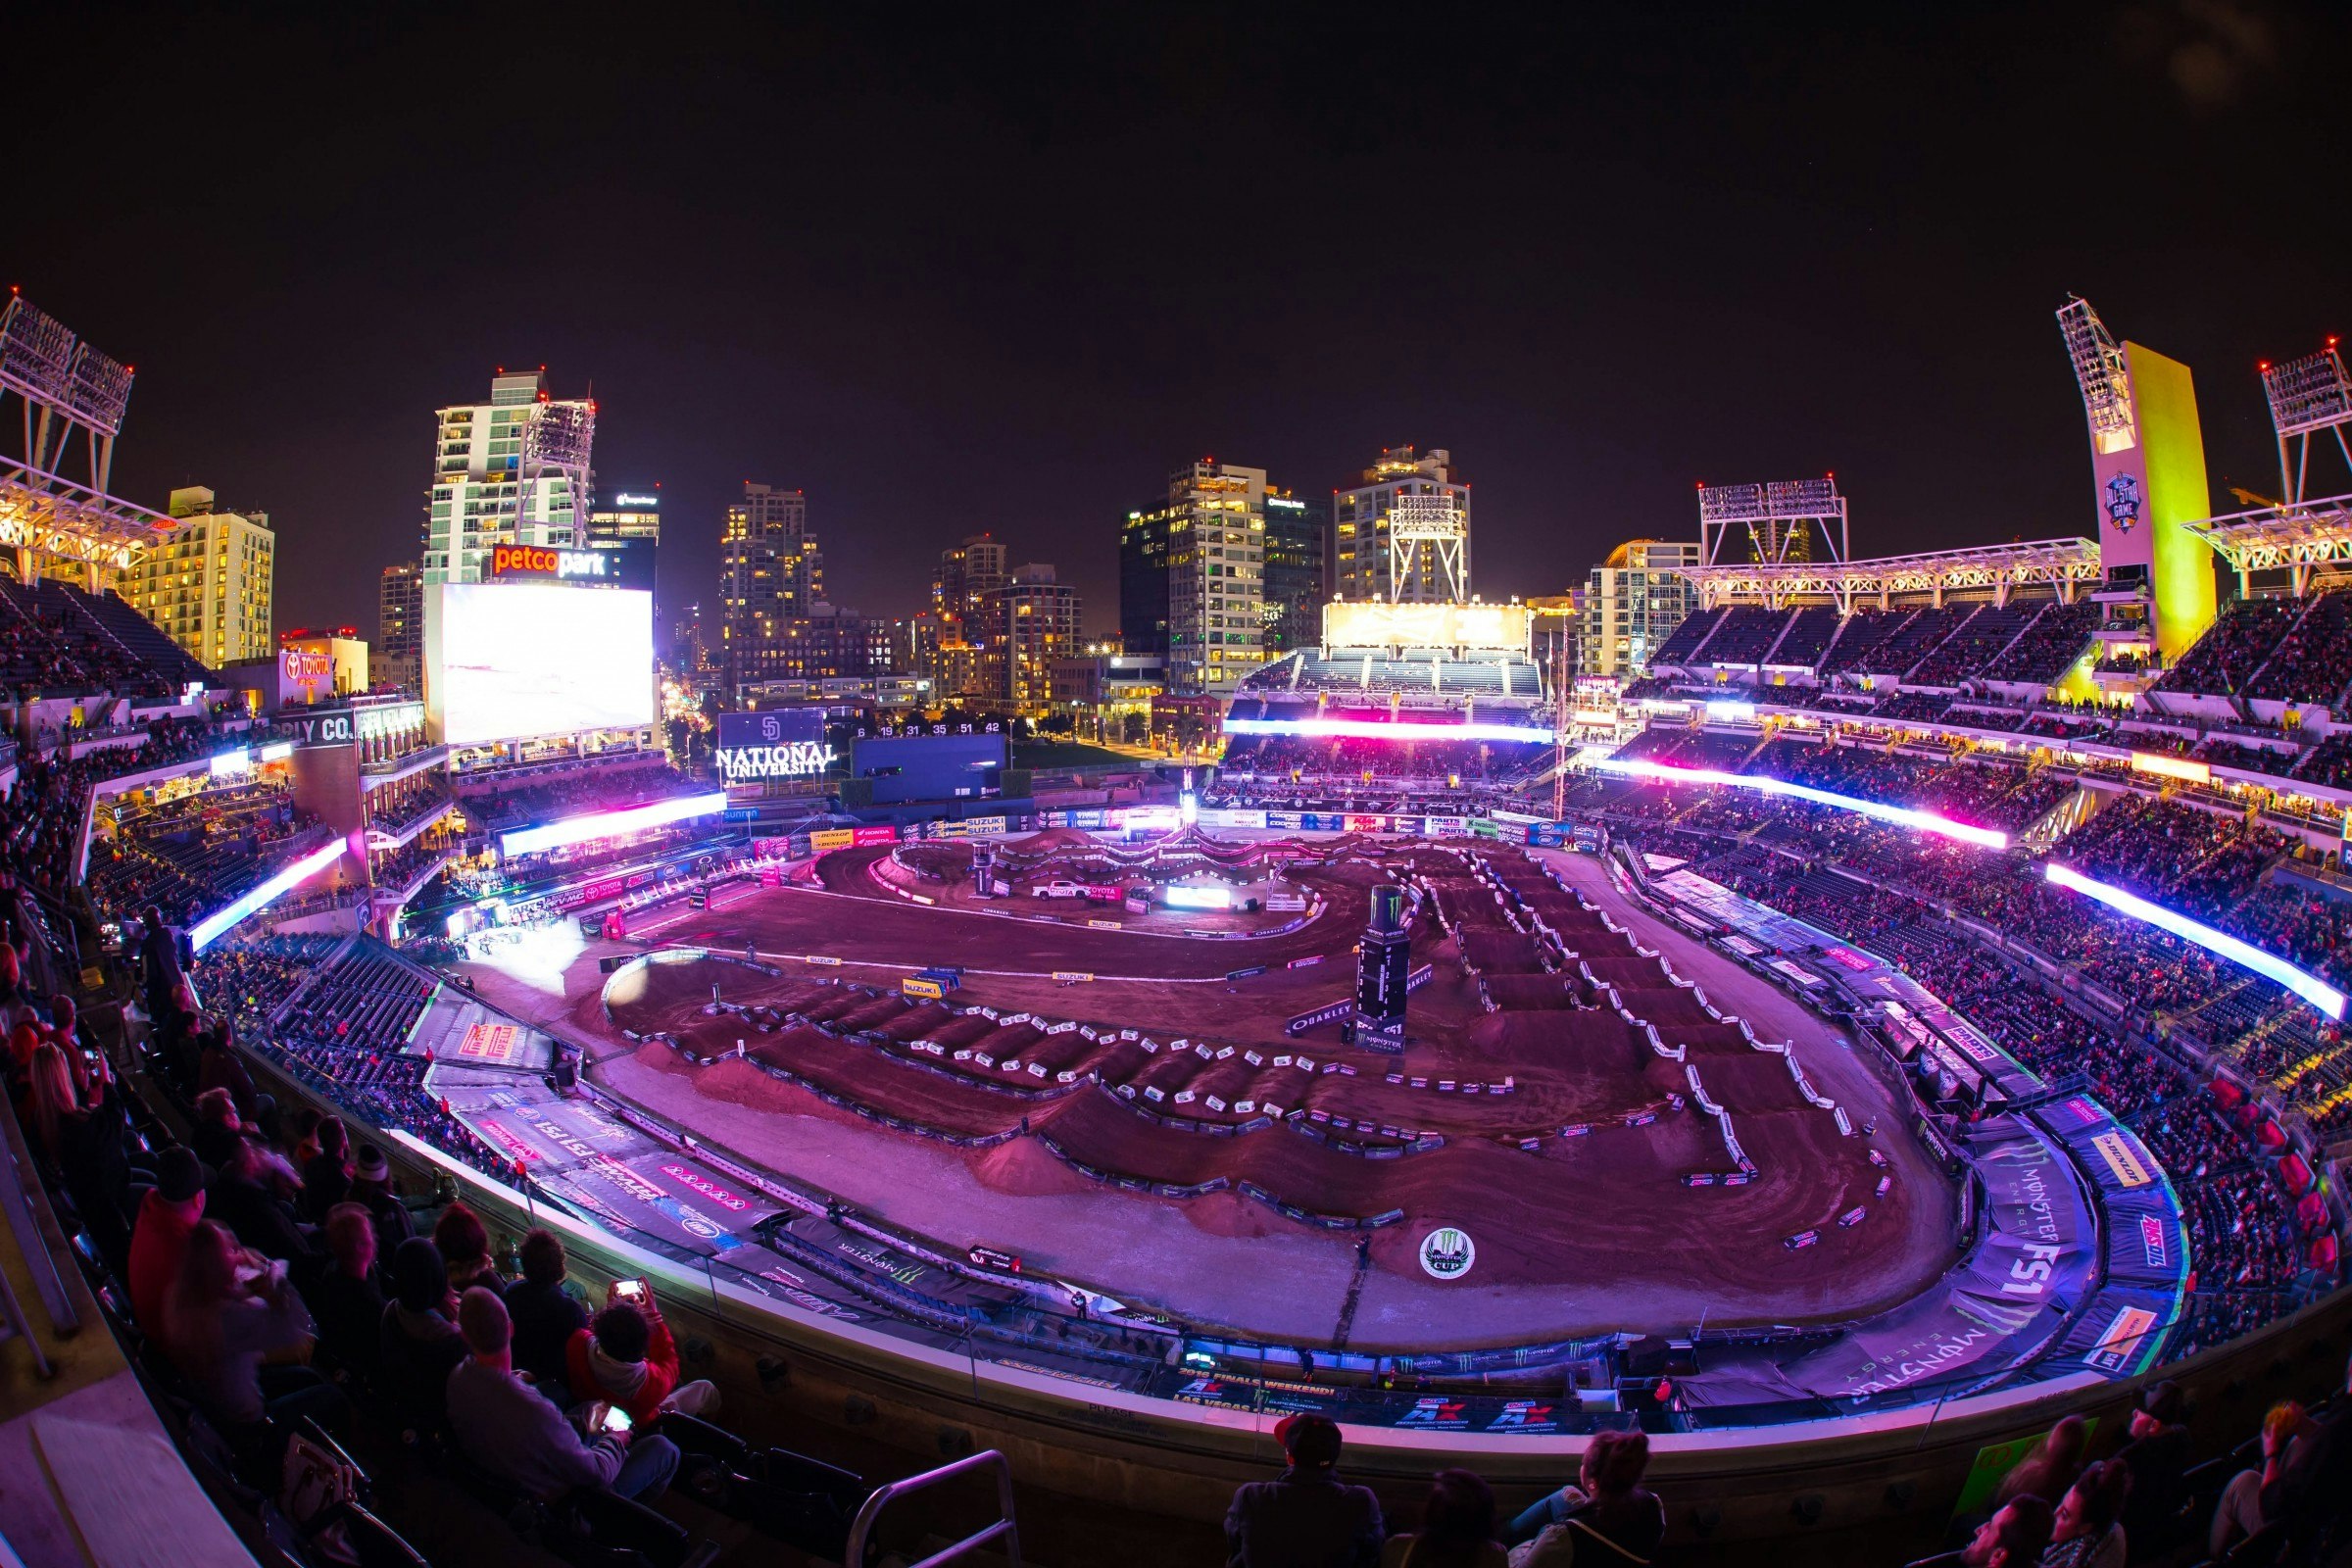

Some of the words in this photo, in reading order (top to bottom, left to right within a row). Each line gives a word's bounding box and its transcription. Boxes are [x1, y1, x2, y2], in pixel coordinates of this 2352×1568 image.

[2114, 503, 2133, 517] GAME
[495, 546, 559, 574] petco
[558, 551, 606, 578] park
[302, 656, 329, 675] TOYOTA
[881, 726, 893, 735] 19
[906, 725, 919, 735] 31
[933, 724, 947, 734] 35
[960, 723, 972, 733] 51
[985, 722, 1000, 732] 42
[715, 744, 837, 767] NATIONAL
[725, 760, 829, 778] UNIVERSITY
[967, 817, 1004, 826] SUZUKI
[1468, 819, 1496, 830] Kawasaki
[1574, 825, 1598, 834] GoPro
[599, 880, 622, 892] TOYOTA
[905, 984, 937, 995] SUZUKI
[1309, 1004, 1351, 1025] OAKLEY
[486, 1026, 513, 1057] PIRELLI
[1366, 1036, 1401, 1049] MONSTER
[1954, 1028, 1995, 1057] PARTS
[534, 1121, 568, 1140] FS1
[559, 1139, 596, 1156] FS1
[2107, 1145, 2140, 1182] DUNLOP
[2009, 1182, 2030, 1236] ENERGY
[2022, 1168, 2060, 1242] MONSTER
[2139, 1213, 2167, 1267] AMSOIL
[839, 1243, 898, 1273] MONSTER
[2001, 1243, 2061, 1294] FS1
[1845, 1333, 1942, 1383] ENERGY
[2100, 1352, 2119, 1367] CAT
[1213, 1373, 1260, 1387] FINALS
[1264, 1380, 1335, 1396] WEEKEND!
[1089, 1402, 1136, 1419] PLEASE
[1204, 1398, 1250, 1412] VEGAS
[1262, 1406, 1294, 1417] MAY
[1268, 1399, 1323, 1410] SUPERCROSS
